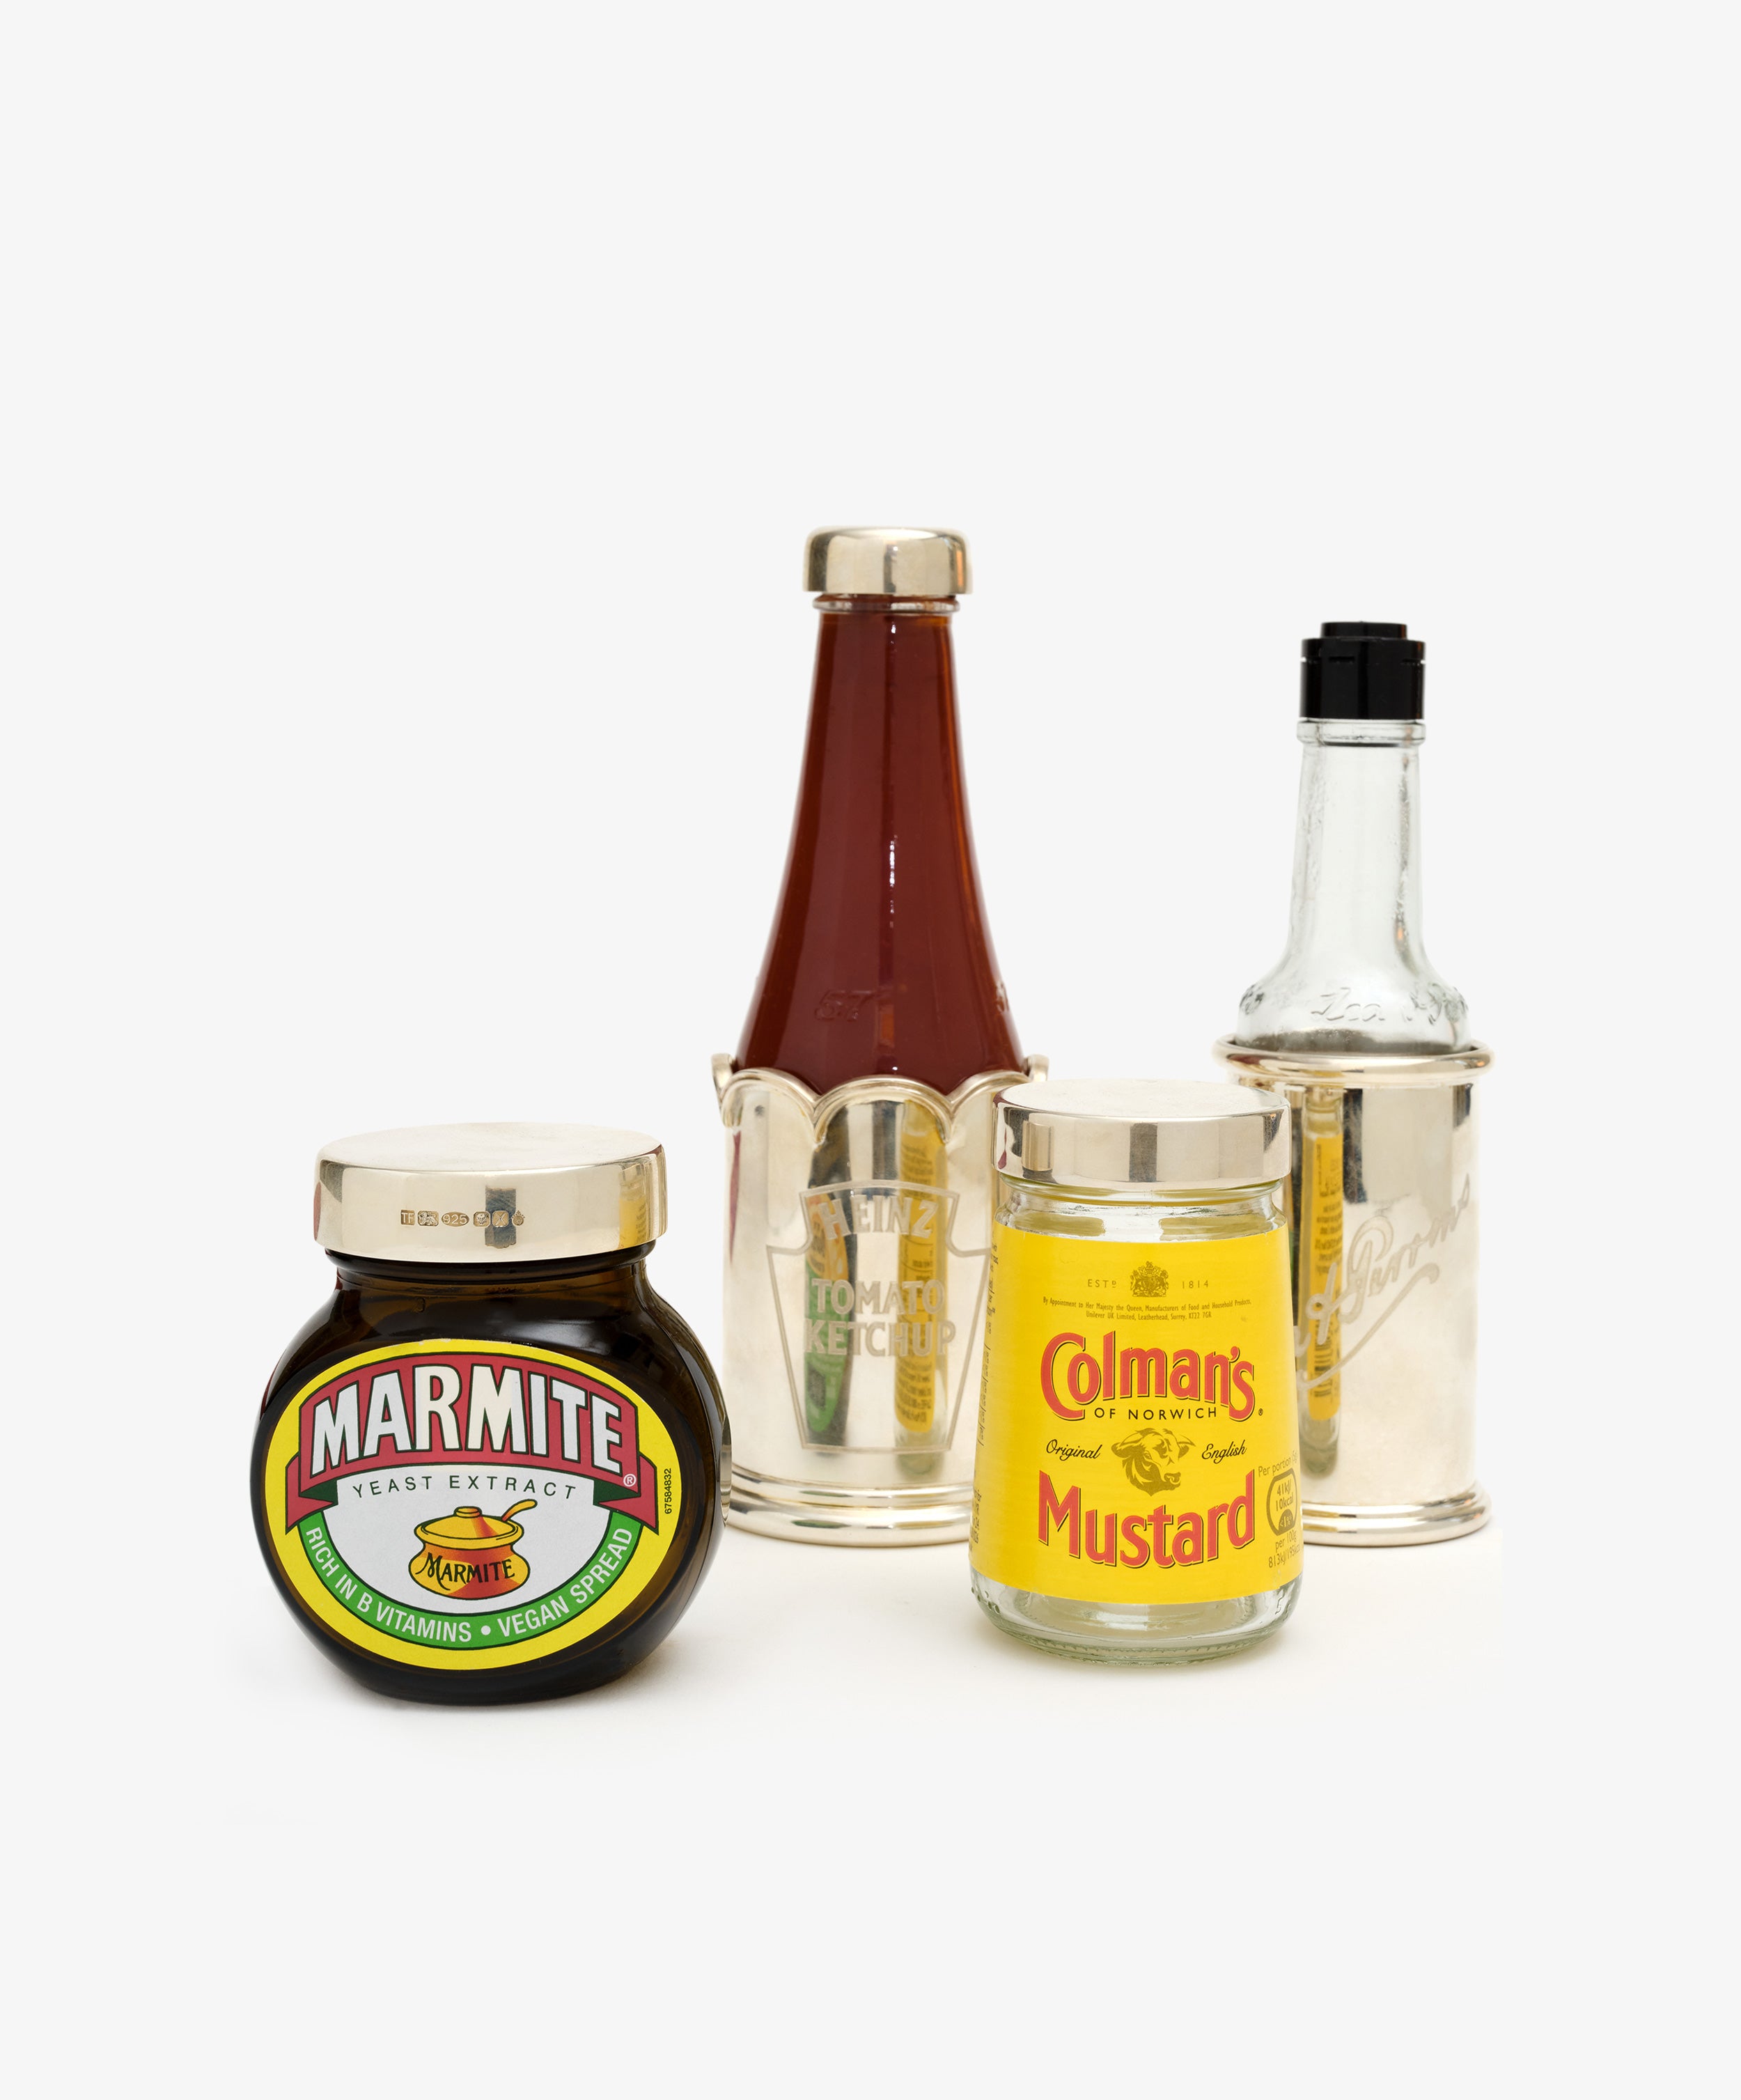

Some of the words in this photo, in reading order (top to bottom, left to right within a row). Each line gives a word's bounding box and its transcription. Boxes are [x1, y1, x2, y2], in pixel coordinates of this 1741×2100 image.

[401, 1212, 414, 1224] TF
[442, 1214, 468, 1224] 925
[818, 1194, 939, 1240] HEINZ
[811, 1277, 945, 1316] TOMATO
[1182, 1280, 1209, 1289] 1814
[1043, 1296, 1048, 1305] By
[1049, 1297, 1077, 1309] Appointment
[1086, 1301, 1094, 1309] Her
[1096, 1302, 1114, 1312] Majesty
[1126, 1304, 1143, 1312] Queen,
[1212, 1300, 1233, 1309] Household
[1086, 1310, 1105, 1319] Unilever
[1171, 1313, 1187, 1321] Surrey,
[804, 1318, 956, 1357] KETCHUP
[1040, 1330, 1256, 1422] Colman's
[310, 1364, 622, 1478] MARMITE
[1094, 1406, 1116, 1420] OF
[1128, 1406, 1217, 1420] NORWICH
[1046, 1438, 1102, 1461] Original
[1201, 1439, 1247, 1464] English
[1258, 1465, 1271, 1477] Per
[1272, 1454, 1292, 1476] portion
[352, 1475, 432, 1498] YEAST
[449, 1475, 576, 1499] EXTRACT
[664, 1468, 672, 1515] 67584832
[1038, 1469, 1256, 1570] Mustard
[1275, 1538, 1285, 1553] per
[415, 1552, 515, 1591] MARMITE
[306, 1527, 339, 1577] RICH
[335, 1576, 358, 1600] IN
[357, 1592, 373, 1612] B
[375, 1601, 472, 1642] VITAMINS
[497, 1595, 570, 1638] VEGAN
[570, 1528, 632, 1603] SPREAD
